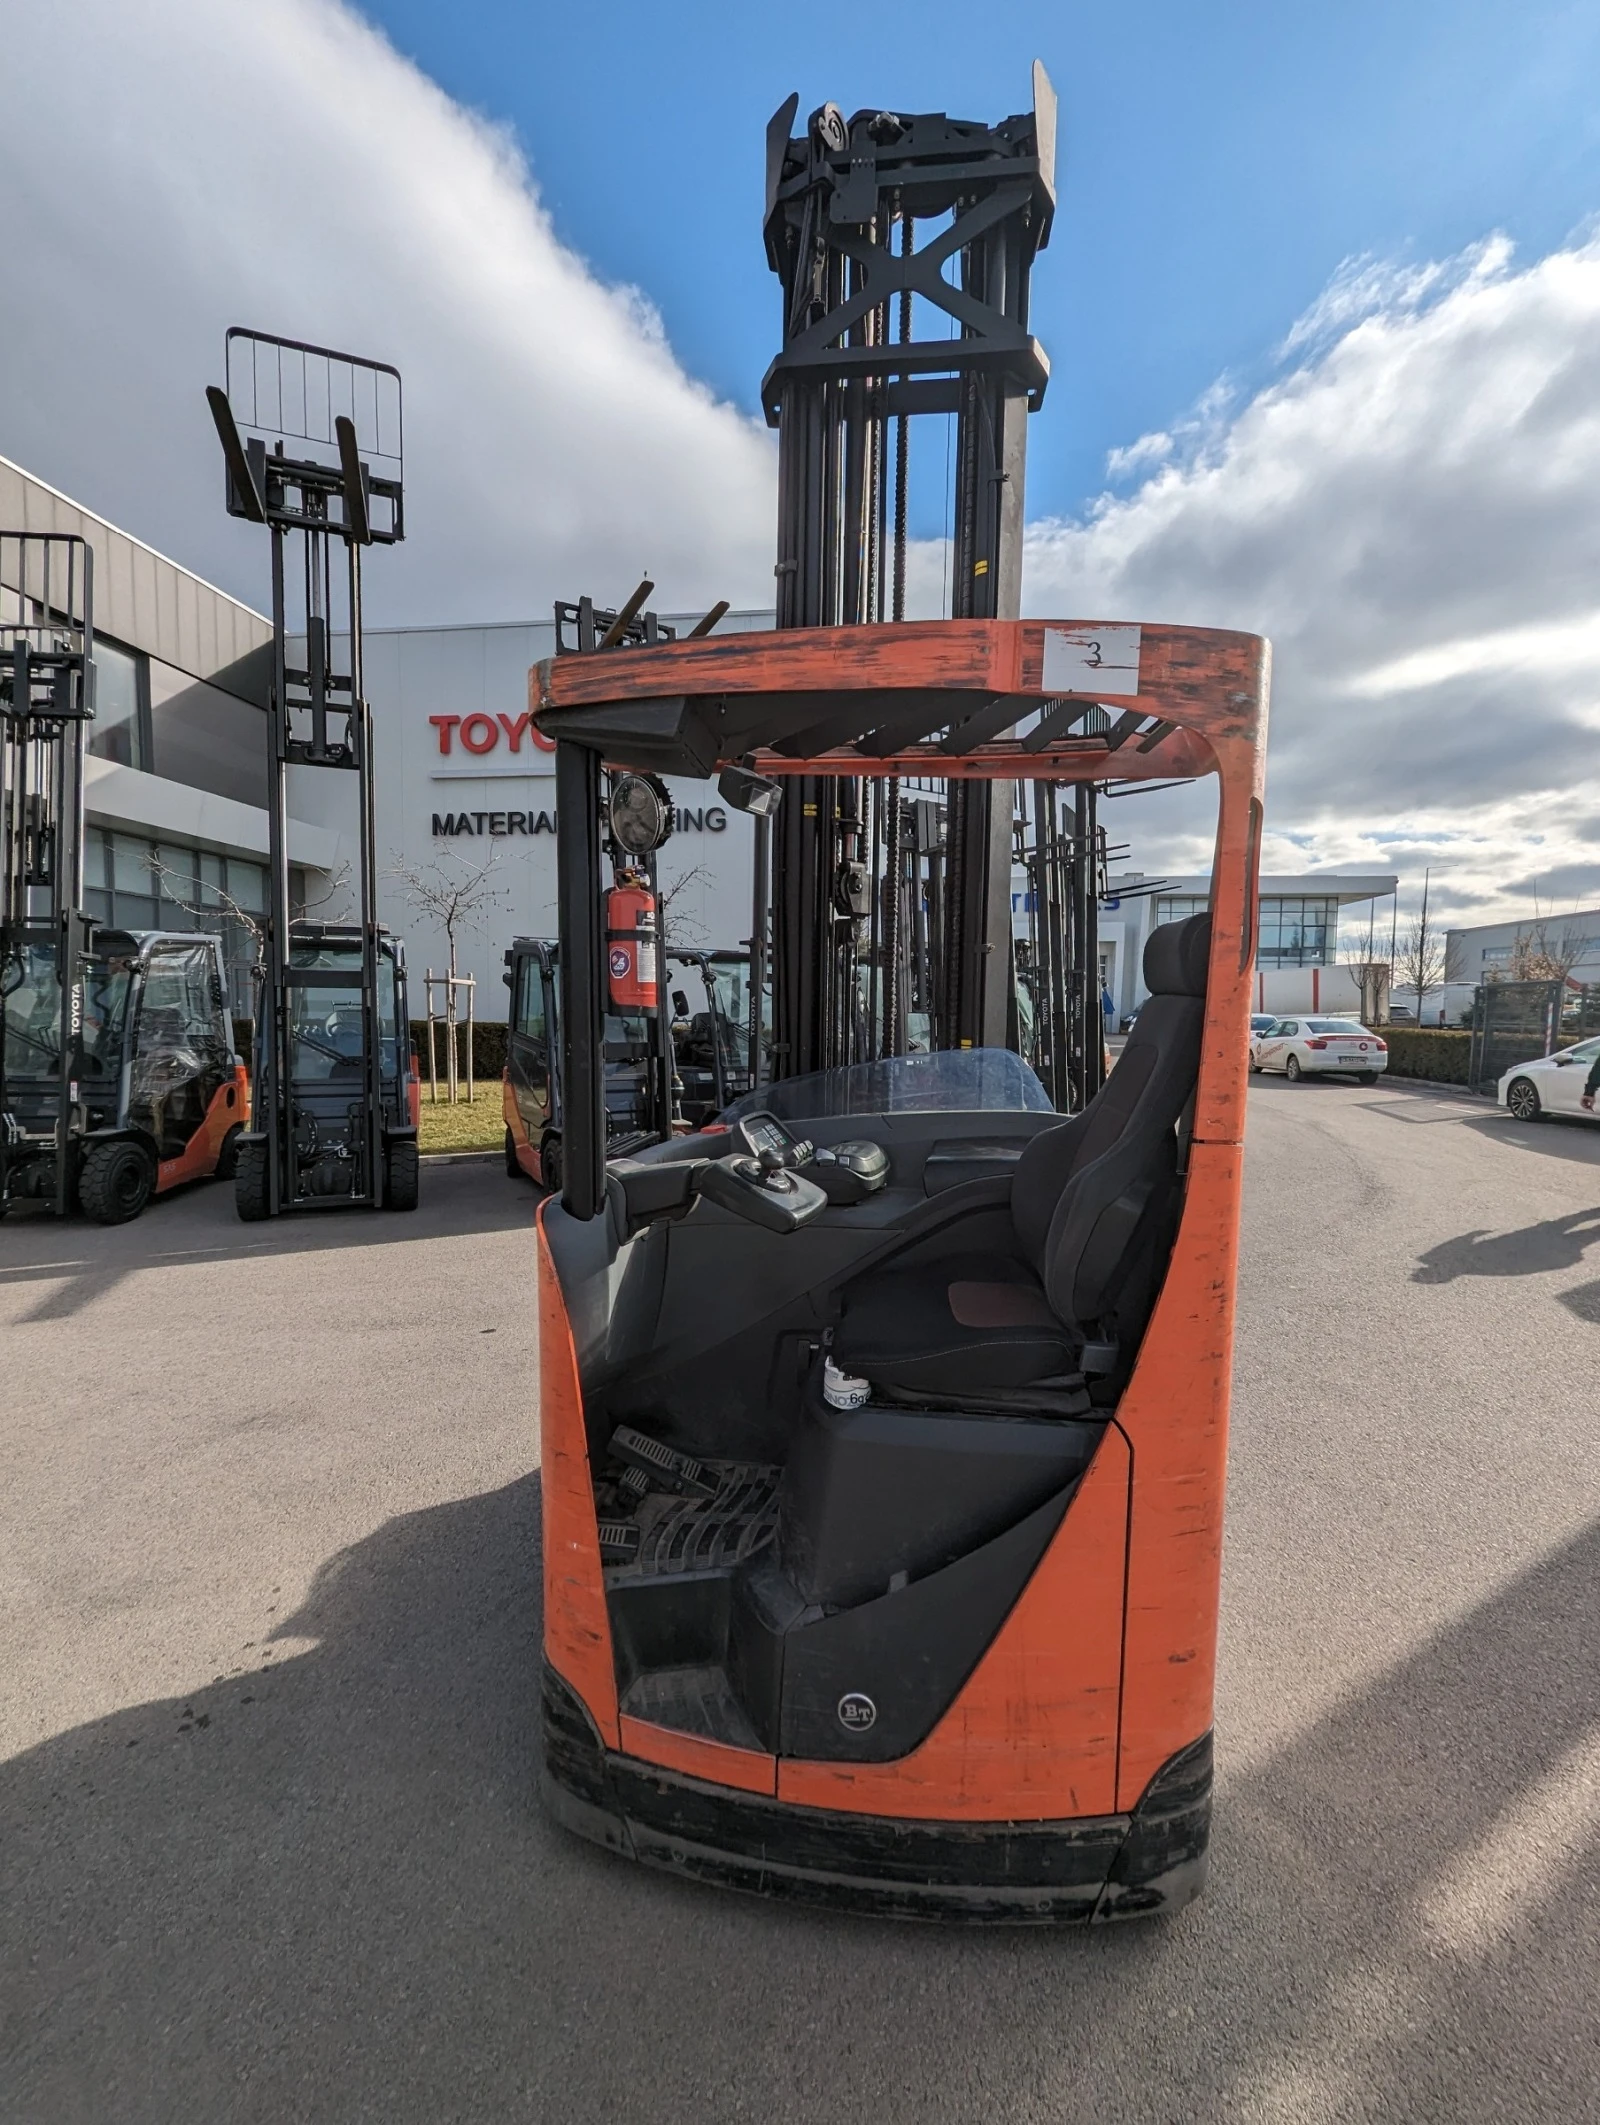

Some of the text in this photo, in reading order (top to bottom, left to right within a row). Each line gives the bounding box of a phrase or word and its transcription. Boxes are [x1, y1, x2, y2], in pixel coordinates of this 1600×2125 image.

[1084, 641, 1102, 667] 3
[676, 806, 727, 833] ING
[70, 983, 81, 1036] TOYOTA
[1041, 997, 1049, 1026] TOYOTA
[844, 1703, 871, 1722] BT
